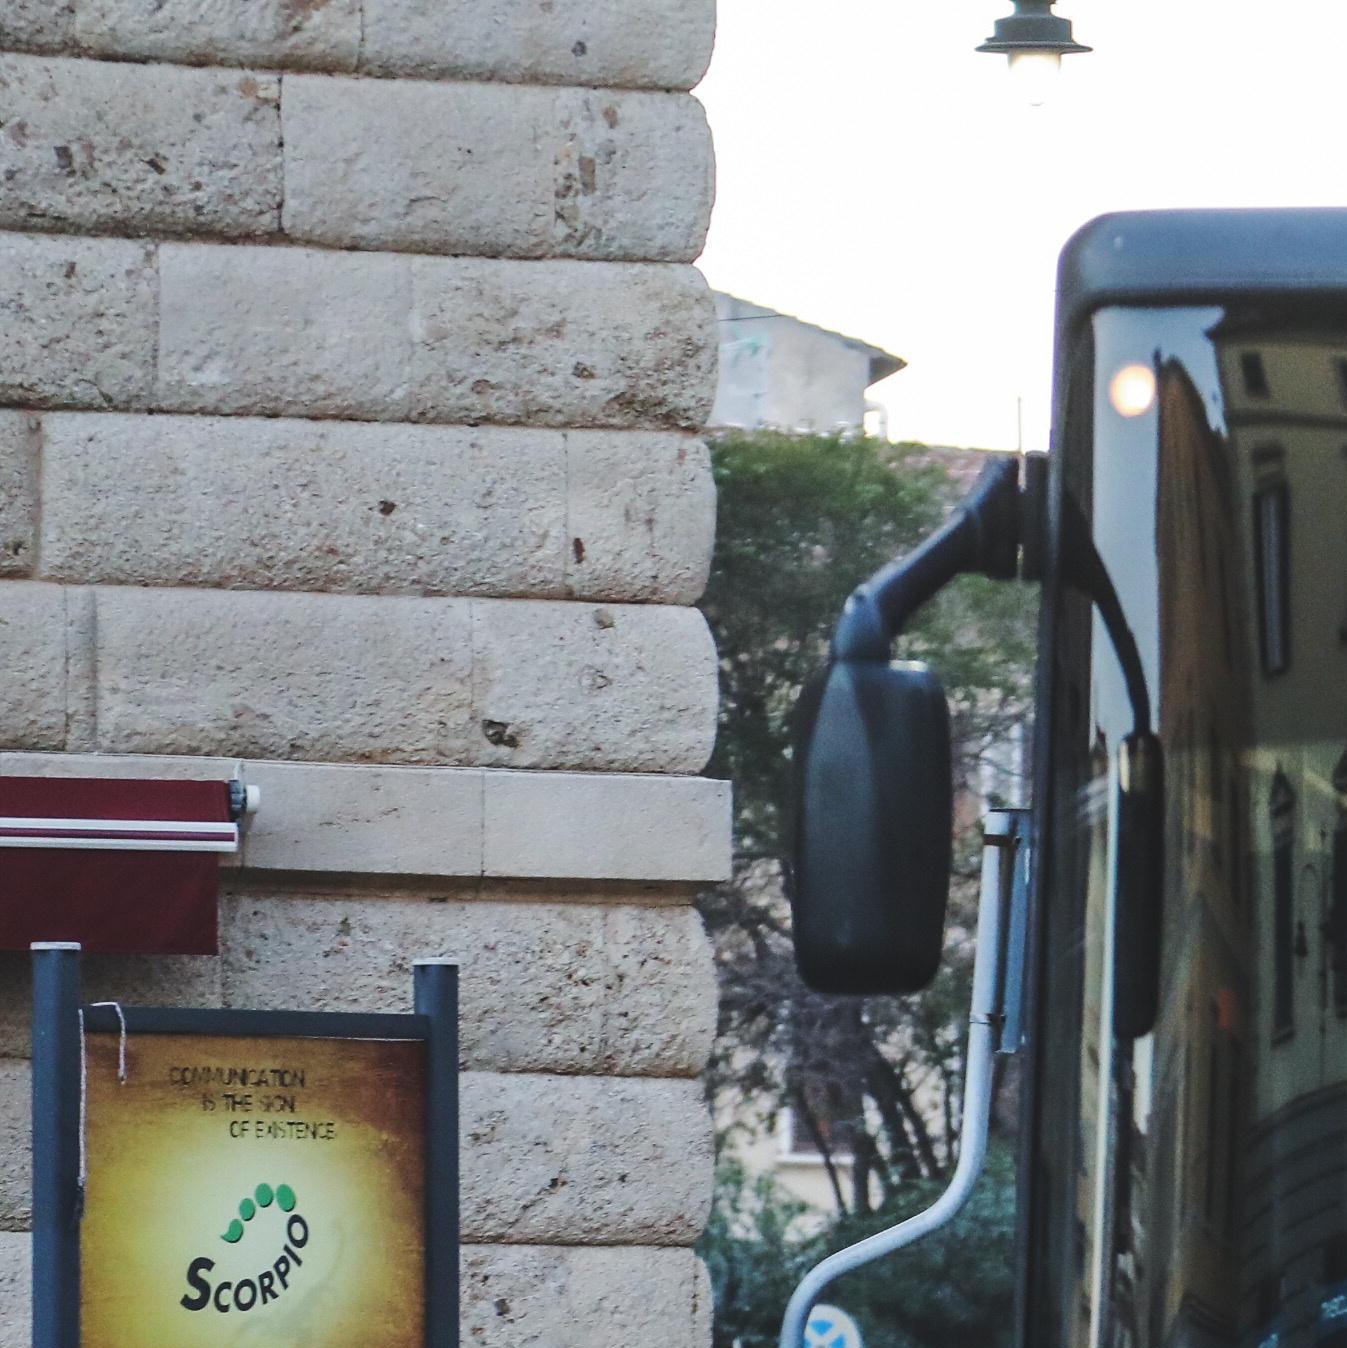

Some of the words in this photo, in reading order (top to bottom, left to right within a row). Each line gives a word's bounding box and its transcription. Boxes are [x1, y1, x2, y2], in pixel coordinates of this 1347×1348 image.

[169, 1066, 305, 1087] COMMUNICATION
[222, 1094, 252, 1112] THE
[230, 1120, 249, 1138] OF
[256, 1121, 336, 1140] EXISTENCE
